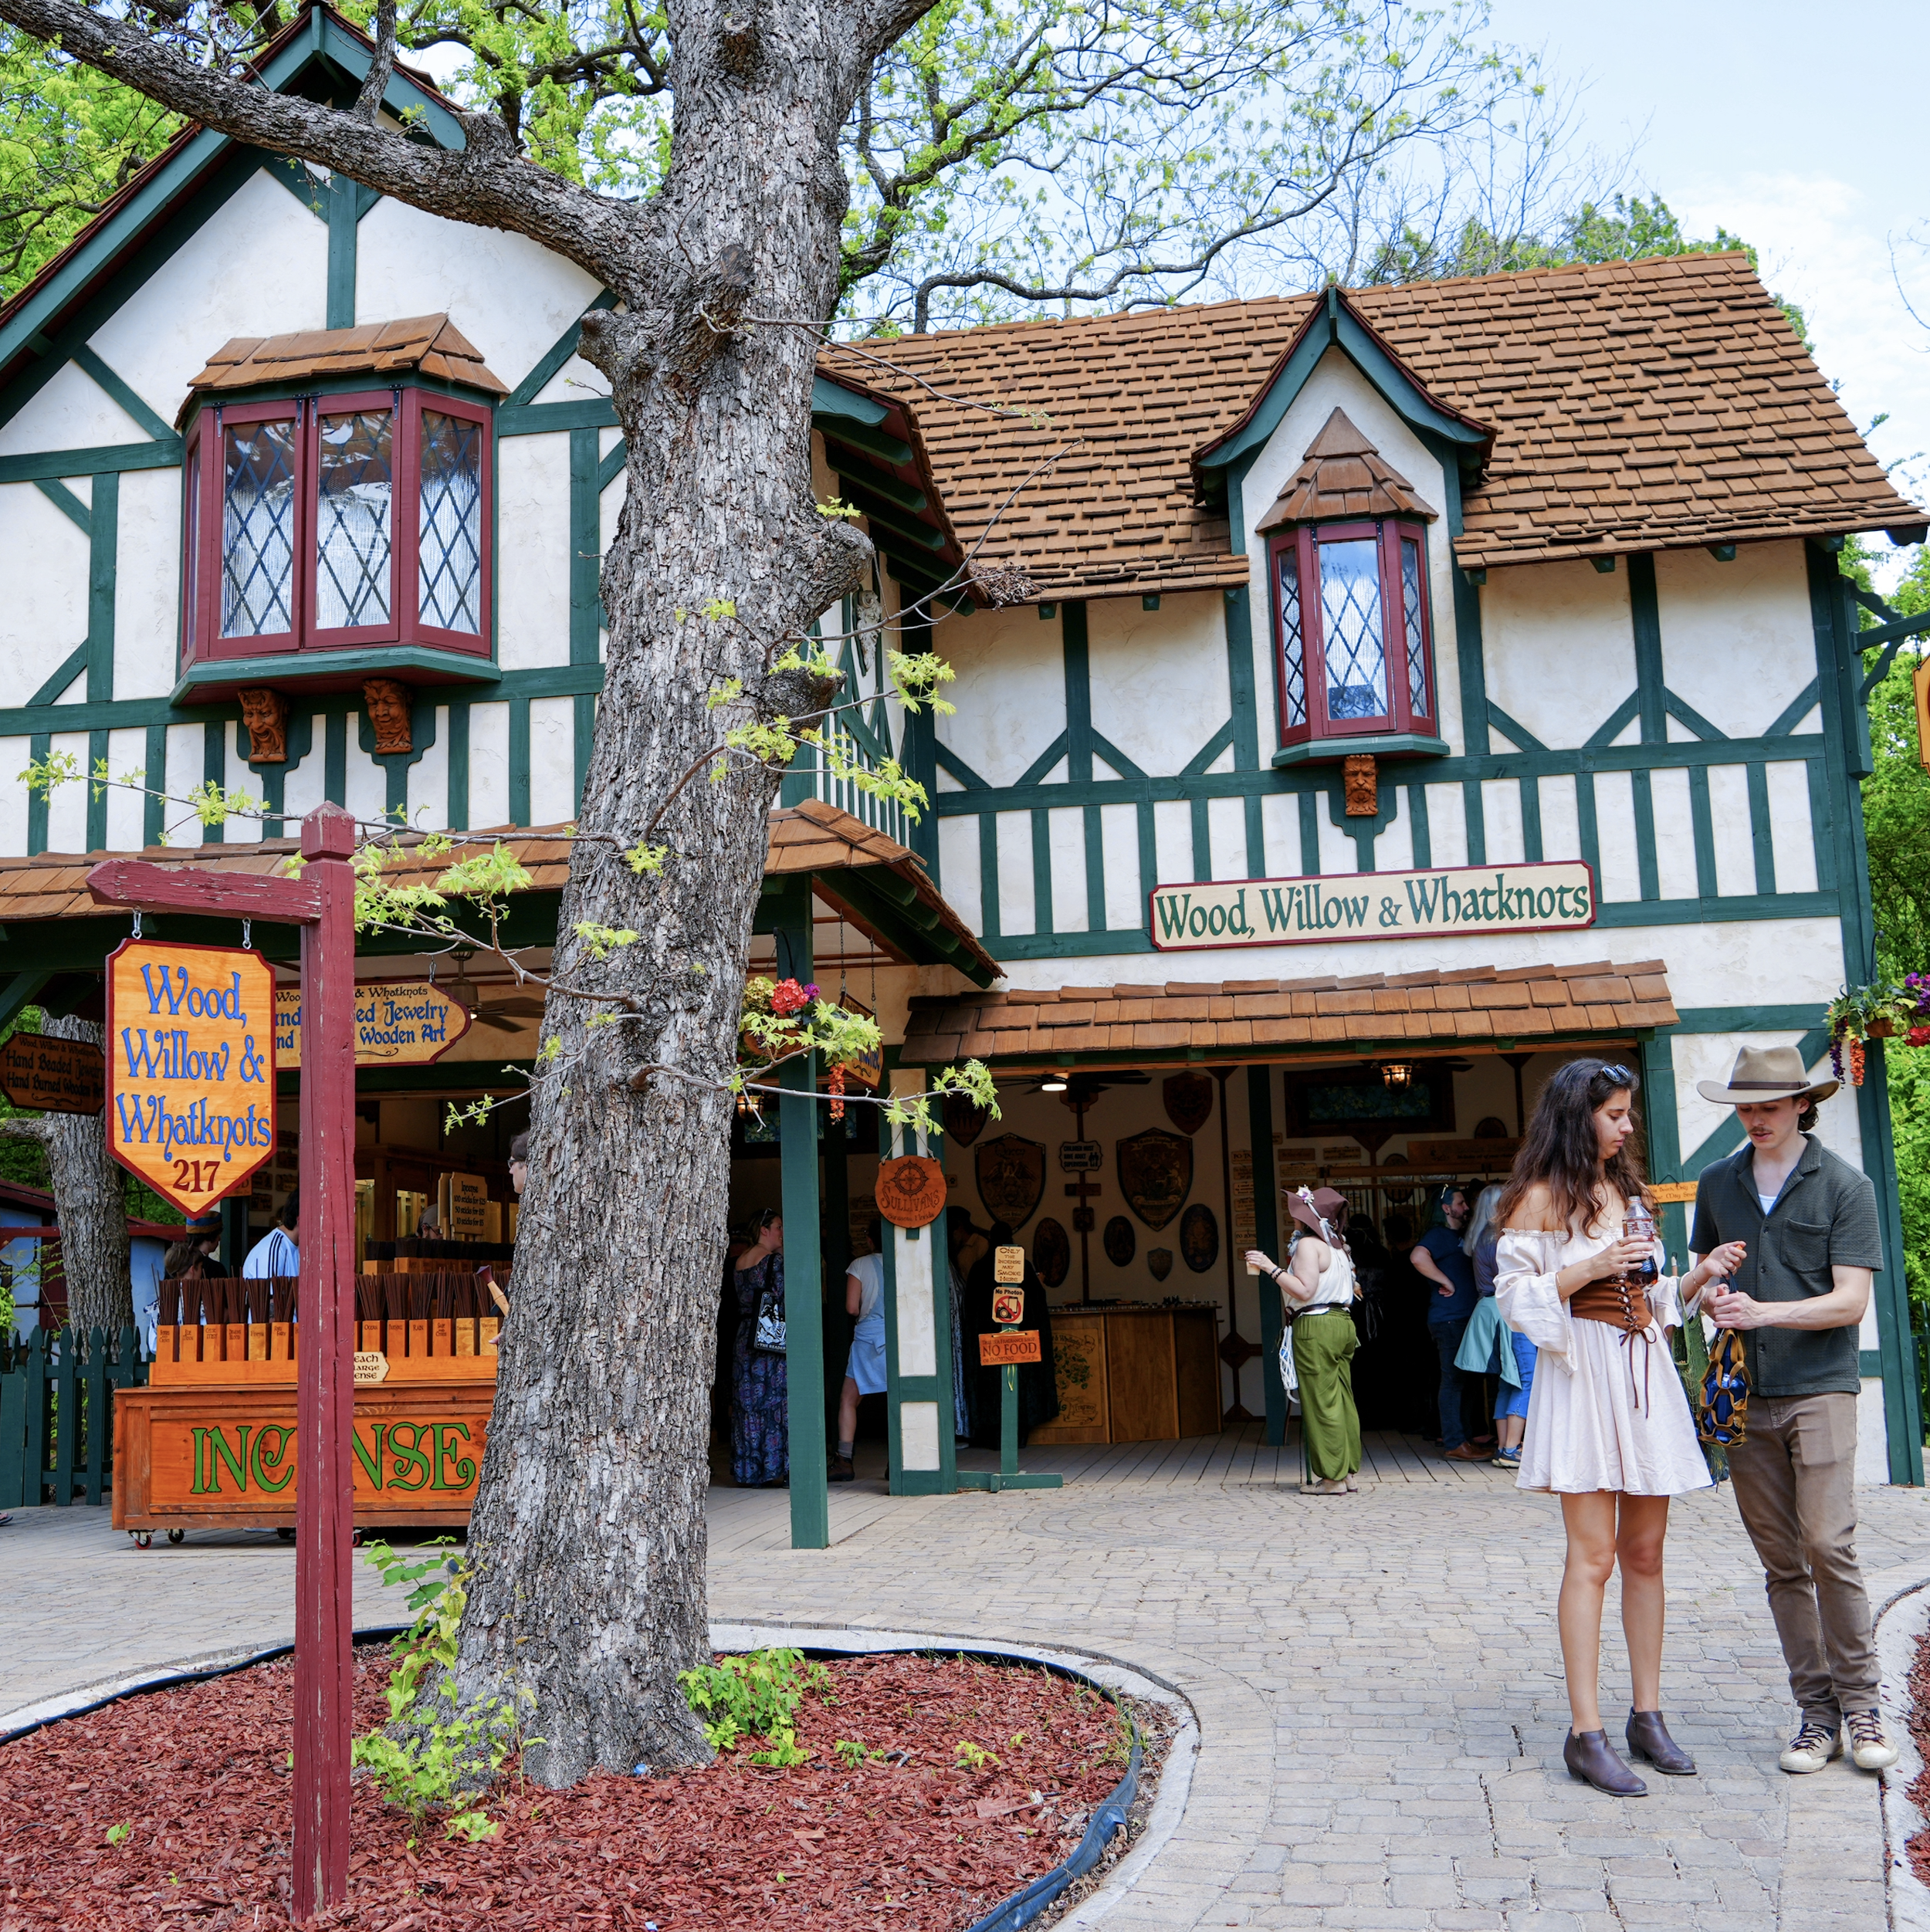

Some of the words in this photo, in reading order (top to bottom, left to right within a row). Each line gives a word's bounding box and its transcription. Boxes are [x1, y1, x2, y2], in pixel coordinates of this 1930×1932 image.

[1155, 888, 1255, 939] Wood,
[1259, 883, 1370, 933] Willow
[1378, 895, 1403, 927] &
[1403, 873, 1590, 925] Whatknots
[140, 963, 247, 1029] Wood,
[354, 989, 364, 998] &
[368, 986, 428, 1000] Whatknots
[383, 1000, 449, 1027] Jewelry
[360, 1025, 416, 1045] Wooden
[422, 1024, 446, 1043] Art
[6, 1050, 34, 1069] Hand
[38, 1053, 72, 1074] Beaded
[121, 1027, 230, 1081] Willow
[239, 1034, 266, 1083] &
[7, 1071, 29, 1089] Hand
[32, 1074, 61, 1093] Burned
[63, 1078, 90, 1096] Wooden
[115, 1092, 271, 1162] Whatknots
[172, 1159, 221, 1193] 217
[881, 1185, 940, 1212] SULLIVANS
[983, 1345, 1001, 1357] NO
[1004, 1342, 1037, 1355] FOOD
[190, 1422, 476, 1494] INCNSE
